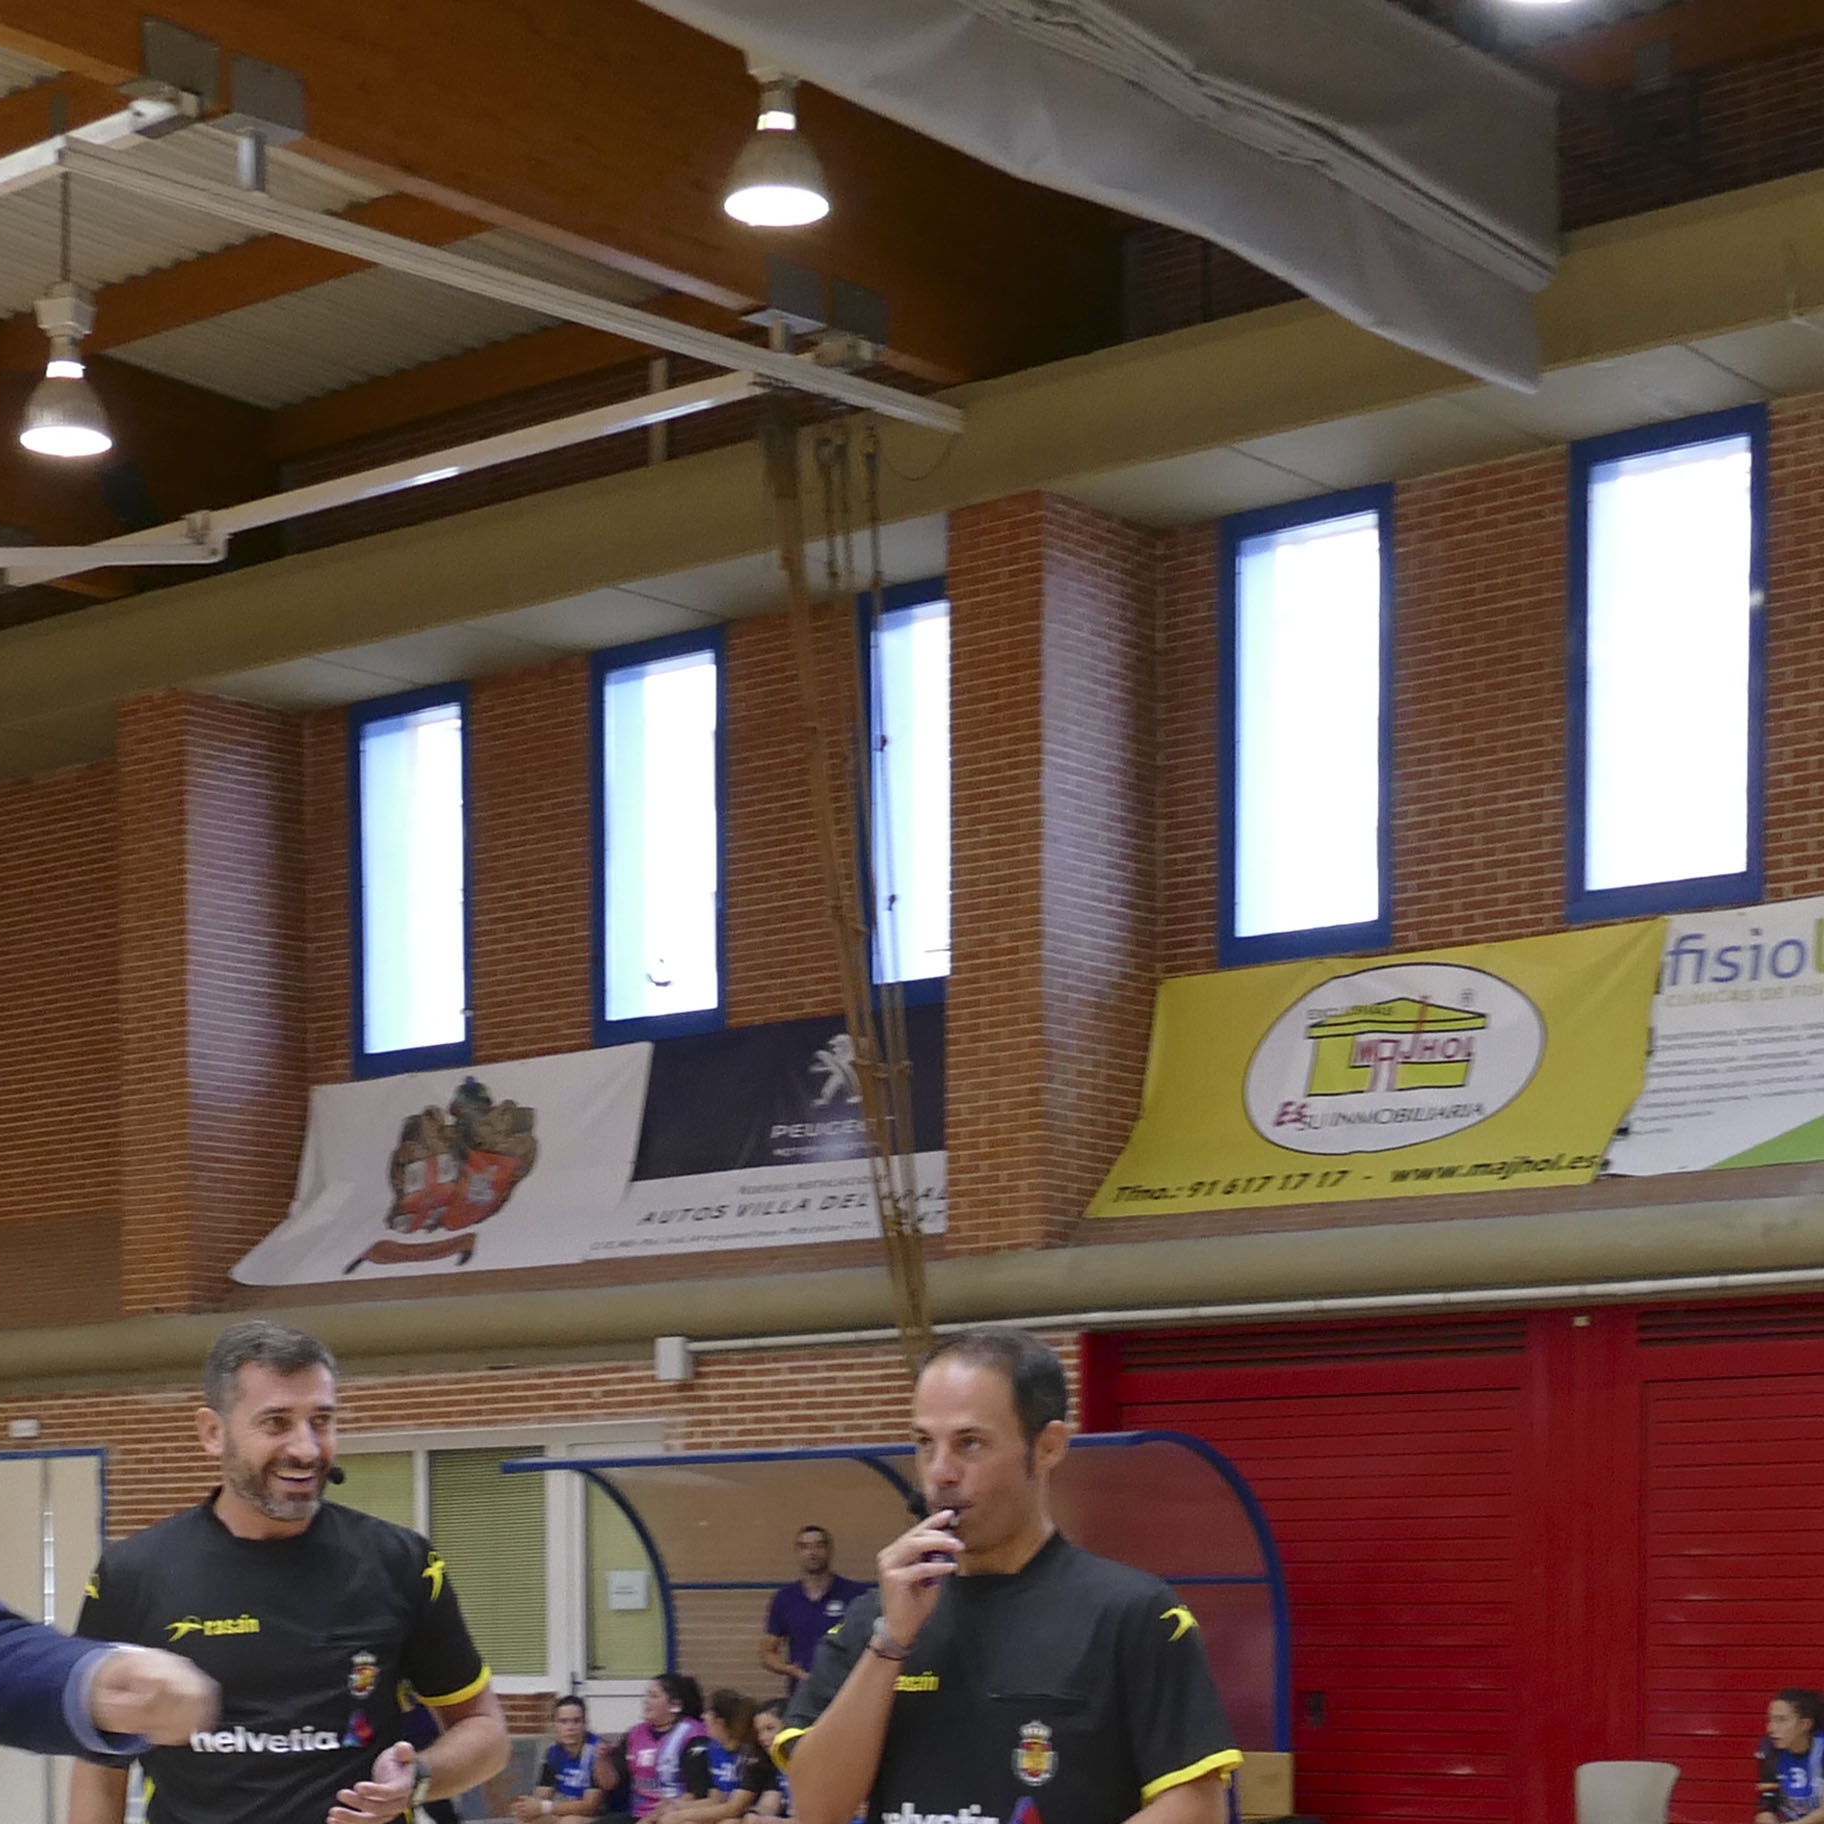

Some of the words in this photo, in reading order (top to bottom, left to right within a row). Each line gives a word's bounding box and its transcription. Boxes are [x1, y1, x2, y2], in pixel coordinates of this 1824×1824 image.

[1186, 1178, 1220, 1198] 91
[1222, 1174, 1273, 1196] 617
[1275, 1171, 1309, 1192] 17
[1314, 1169, 1350, 1190] 17
[1389, 1152, 1602, 1185] www.majhol.es
[636, 1203, 730, 1228] AUTOS
[735, 1195, 812, 1219] VILLA
[816, 1191, 869, 1212] DEL
